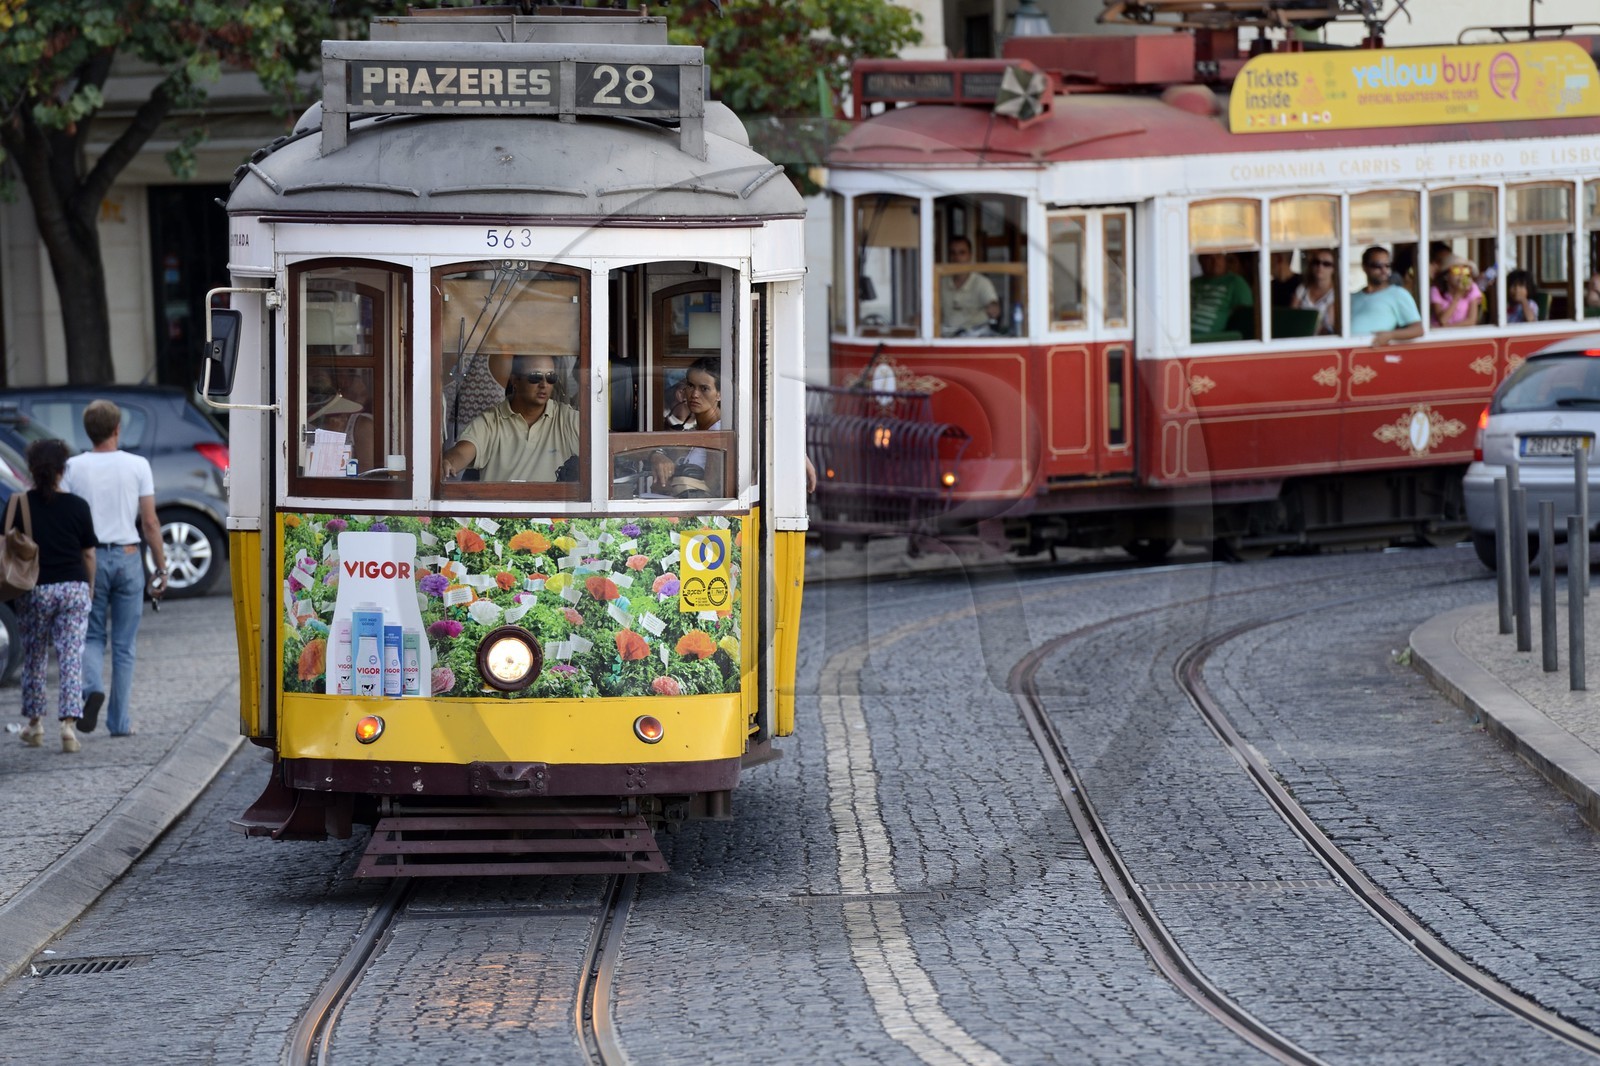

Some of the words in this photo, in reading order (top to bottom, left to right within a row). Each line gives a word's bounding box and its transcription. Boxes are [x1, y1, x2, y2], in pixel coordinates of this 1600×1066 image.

[362, 67, 551, 95] PRAZERES
[592, 65, 655, 104] 28
[1246, 68, 1298, 88] Tickets
[1352, 56, 1437, 89] yellow
[1442, 54, 1480, 83] bus
[1230, 161, 1326, 181] COMPANHIA
[1339, 158, 1401, 175] CARRIS
[1416, 155, 1434, 172] DE
[1448, 152, 1504, 169] FERRO
[1520, 149, 1539, 166] DE
[486, 228, 531, 248] 563
[344, 560, 410, 579] VIGOR
